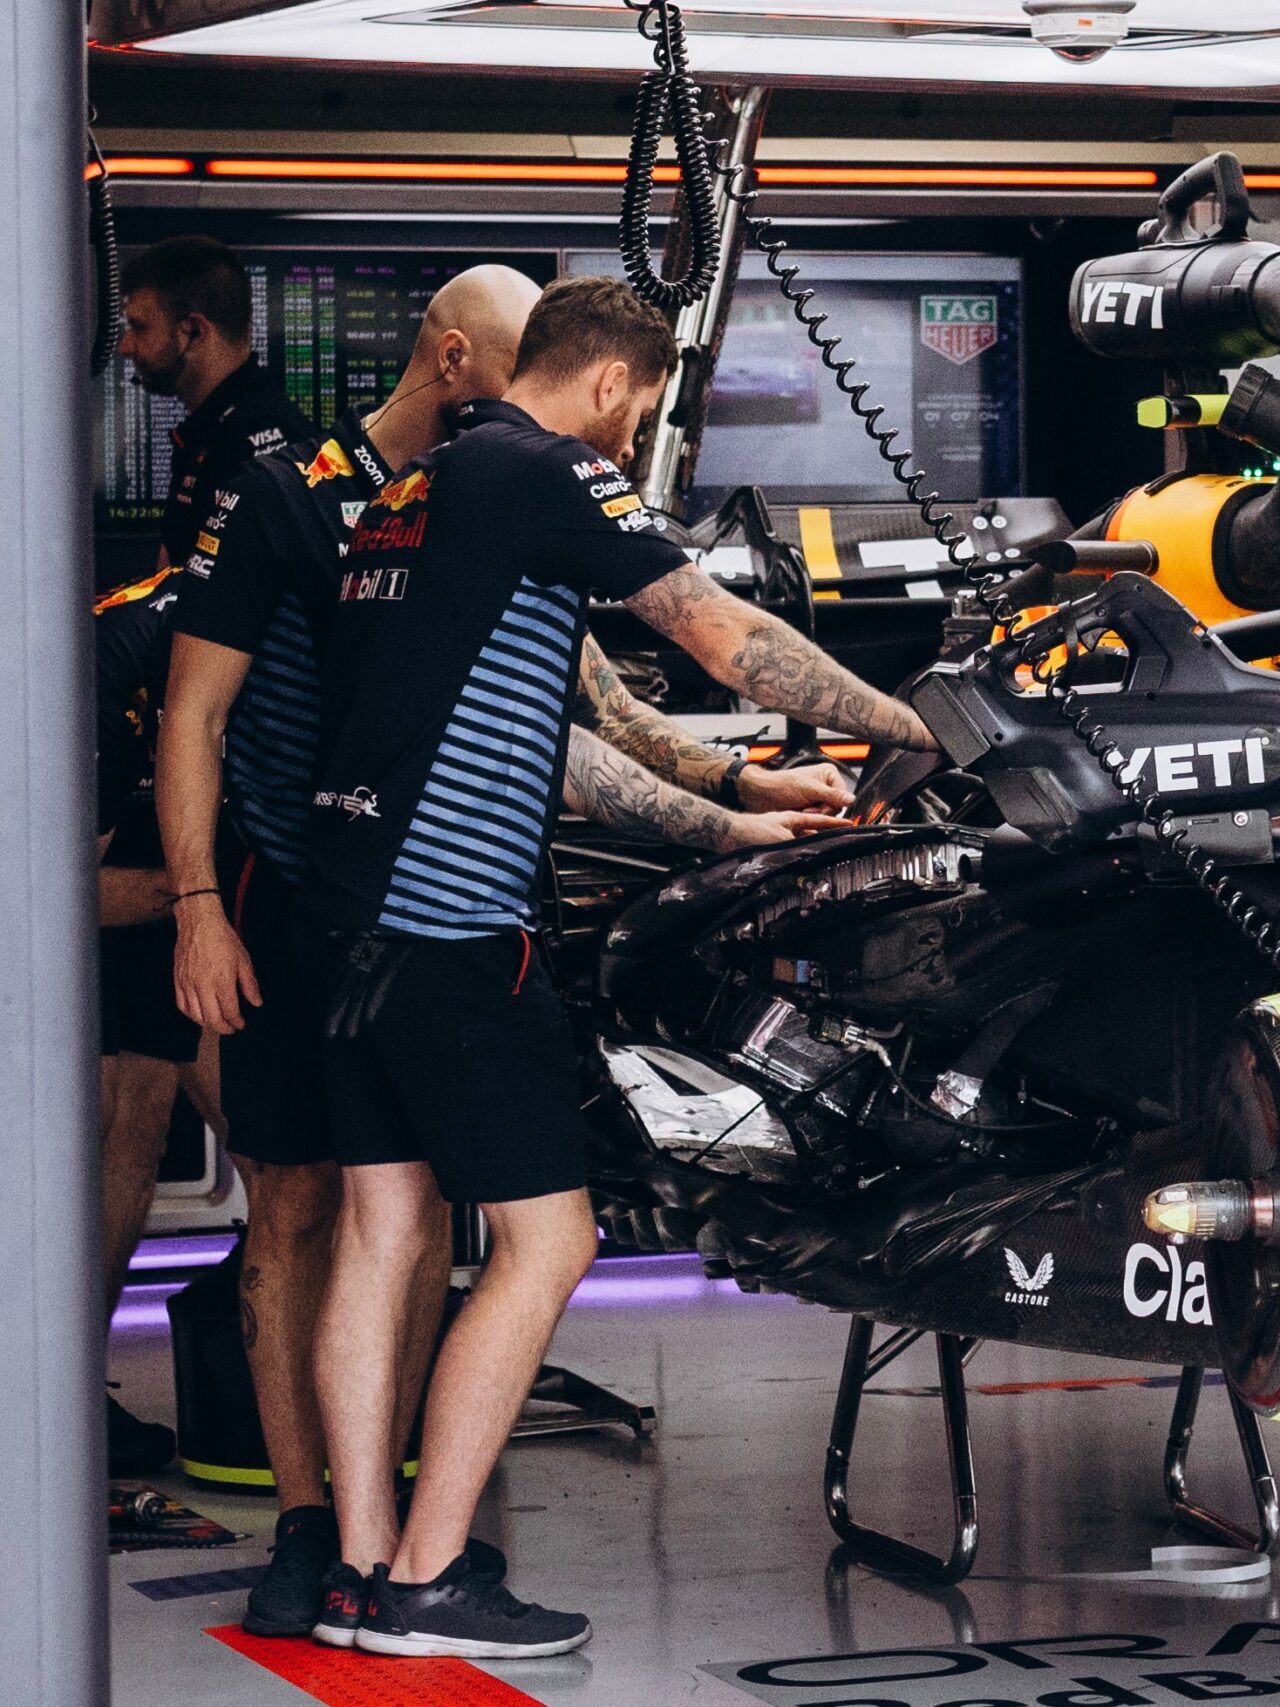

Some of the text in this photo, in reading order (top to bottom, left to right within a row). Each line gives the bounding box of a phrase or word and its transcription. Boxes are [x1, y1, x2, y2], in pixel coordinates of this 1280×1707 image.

[927, 301, 991, 322] TAG
[1082, 282, 1164, 329] YETI
[925, 325, 994, 359] HEUER
[248, 427, 284, 447] VISA
[354, 445, 386, 486] zoom
[590, 480, 629, 499] Claro
[1107, 737, 1267, 796] YETI
[1005, 1292, 1050, 1307] CASTORE
